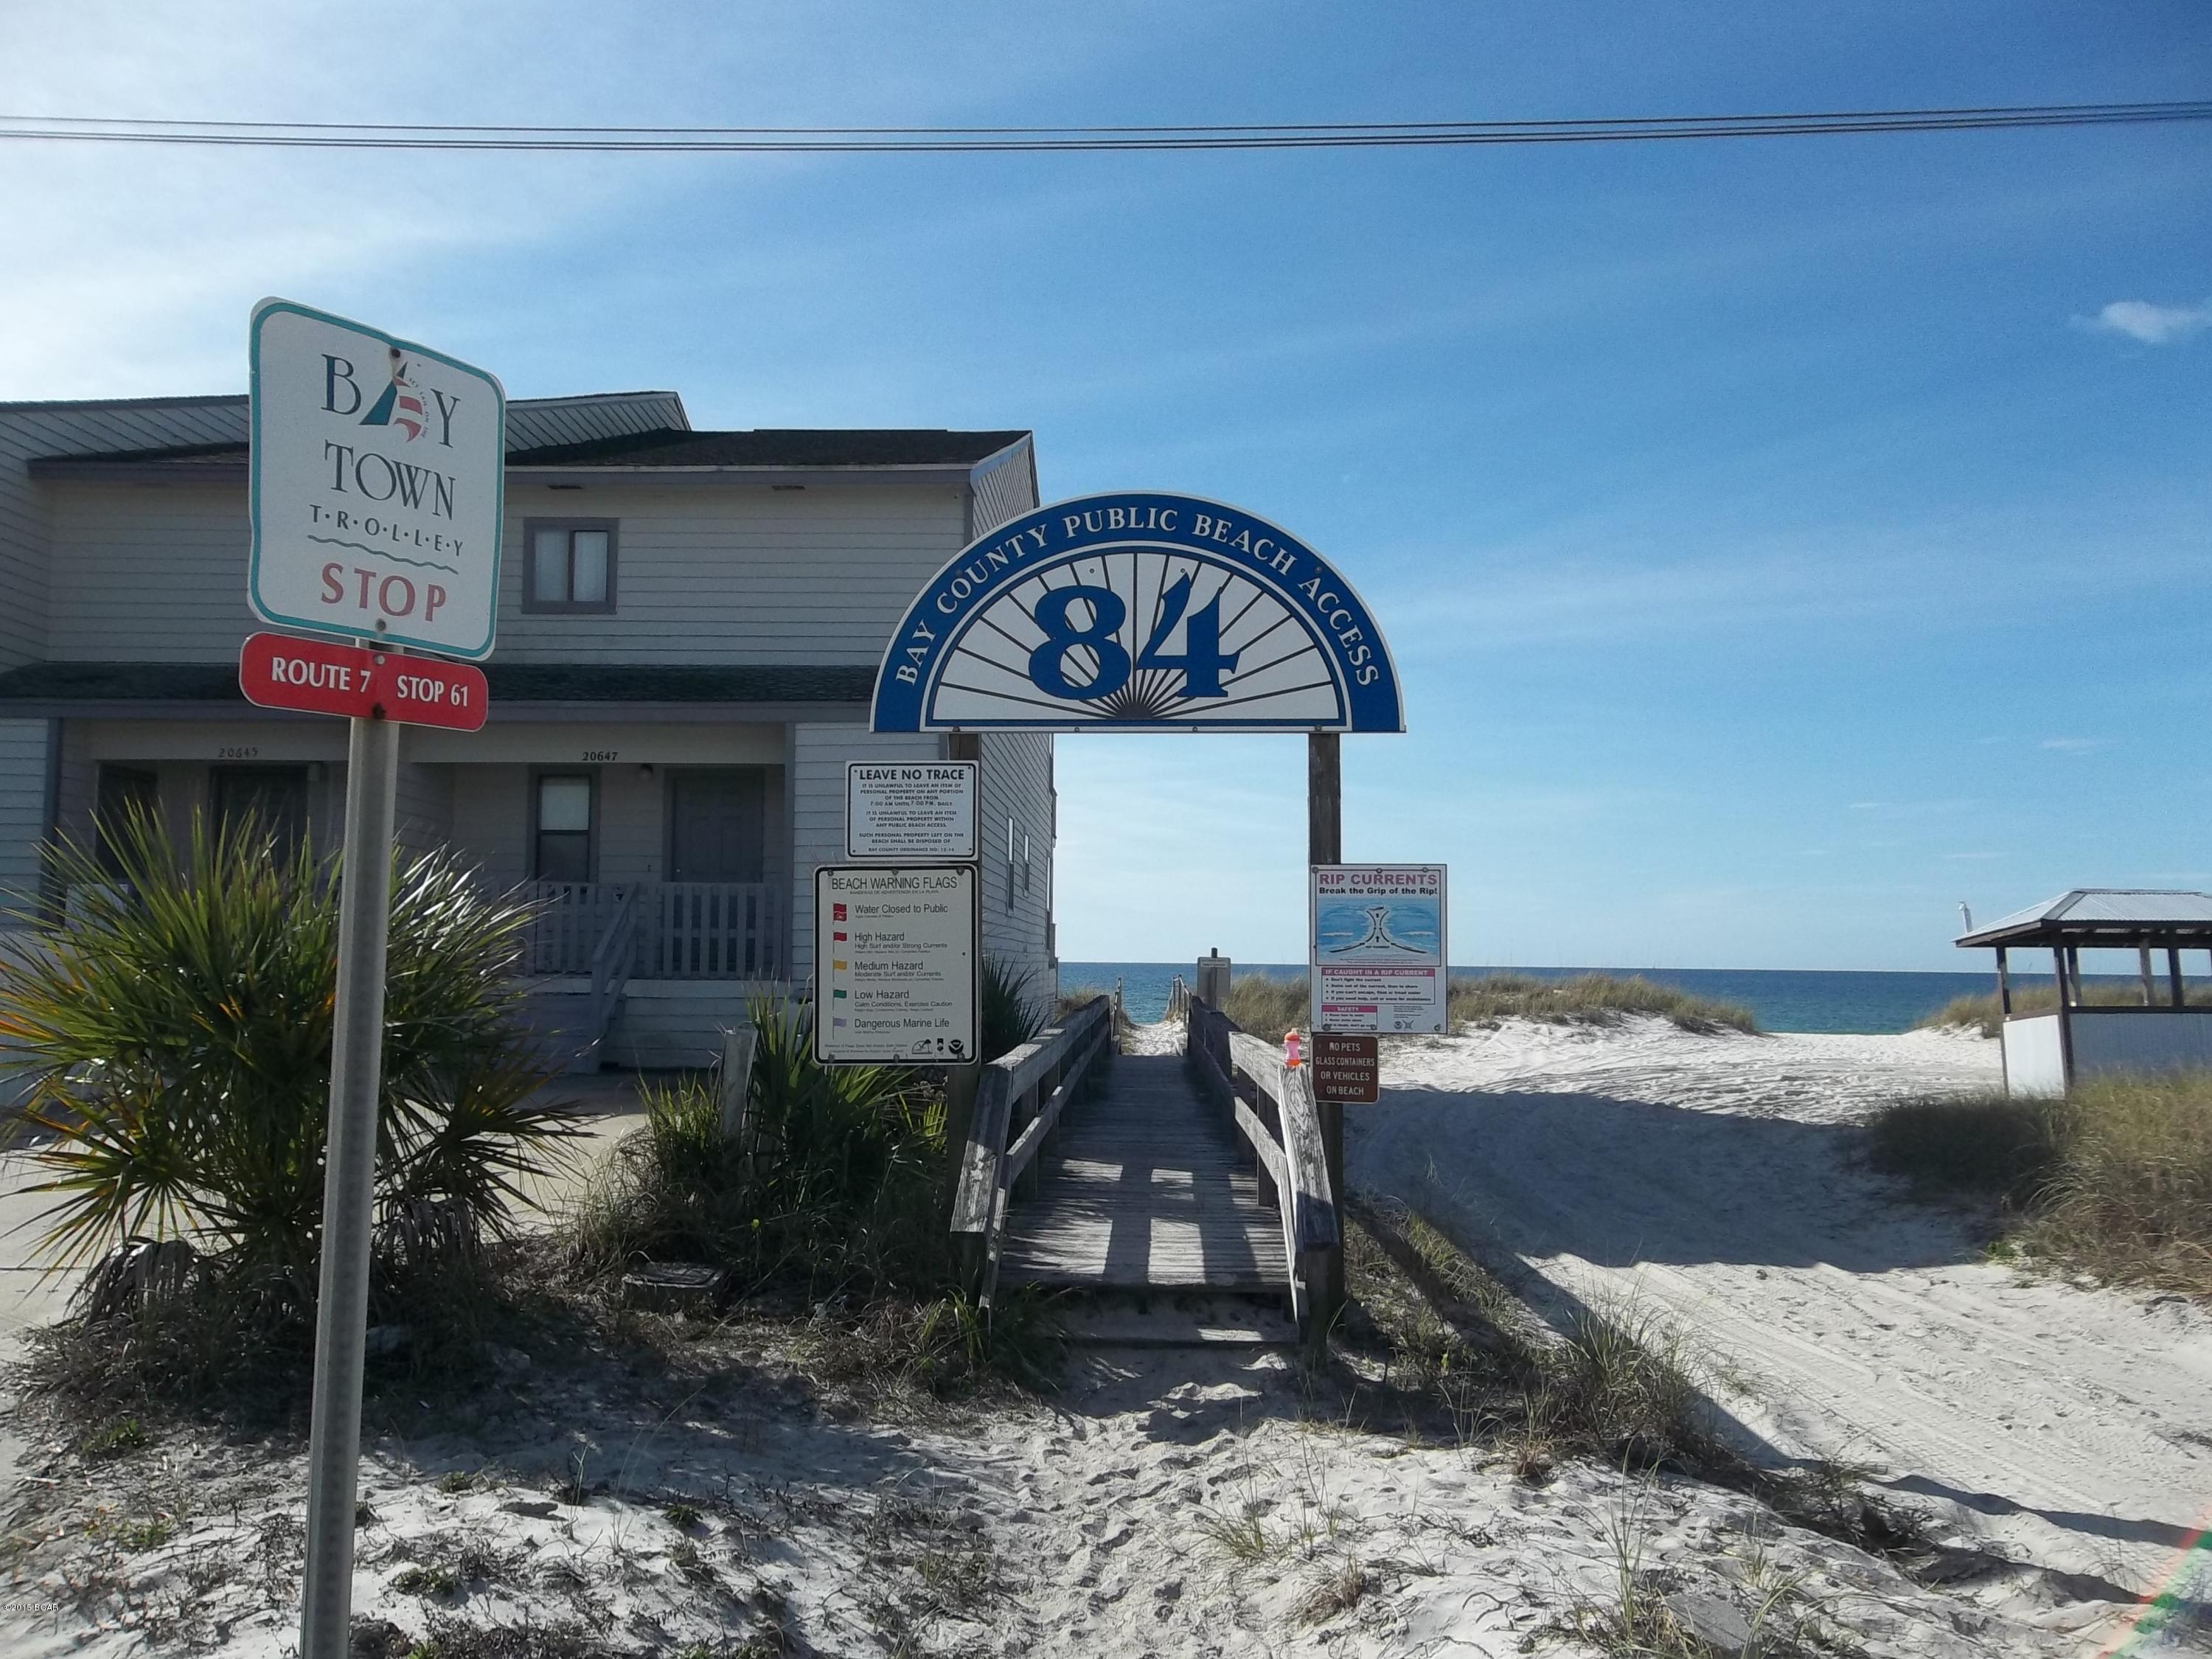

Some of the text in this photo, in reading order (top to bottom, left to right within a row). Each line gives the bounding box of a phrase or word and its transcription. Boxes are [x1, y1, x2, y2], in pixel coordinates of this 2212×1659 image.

[324, 439, 456, 521] TOWN
[321, 562, 446, 622] STOP
[895, 507, 1380, 686] BAY COUNTY PUBLIC BEACH ACCESS
[1028, 571, 1242, 700] 84
[271, 655, 470, 708] ROUTE 7 STOP 61
[582, 751, 619, 761] 20647
[859, 769, 964, 780] LEAVE NO TRACE
[832, 876, 957, 890] BEACH WARNING FLAGS
[1320, 874, 1437, 885] RIP CURRENTS
[855, 905, 879, 914] Water
[881, 904, 911, 913] Closed
[924, 904, 948, 913] Public
[855, 932, 905, 943] High Hazard
[855, 961, 923, 970] Medium Hazard
[855, 990, 909, 999] Low Hazard
[855, 1018, 949, 1030] Dangerous Marine Life
[1329, 1042, 1360, 1051] NO PETS
[1315, 1056, 1375, 1066] GLASS CONTAINERS
[1320, 1071, 1370, 1081] OR VEHICLES
[1326, 1086, 1364, 1095] ON BEACH
